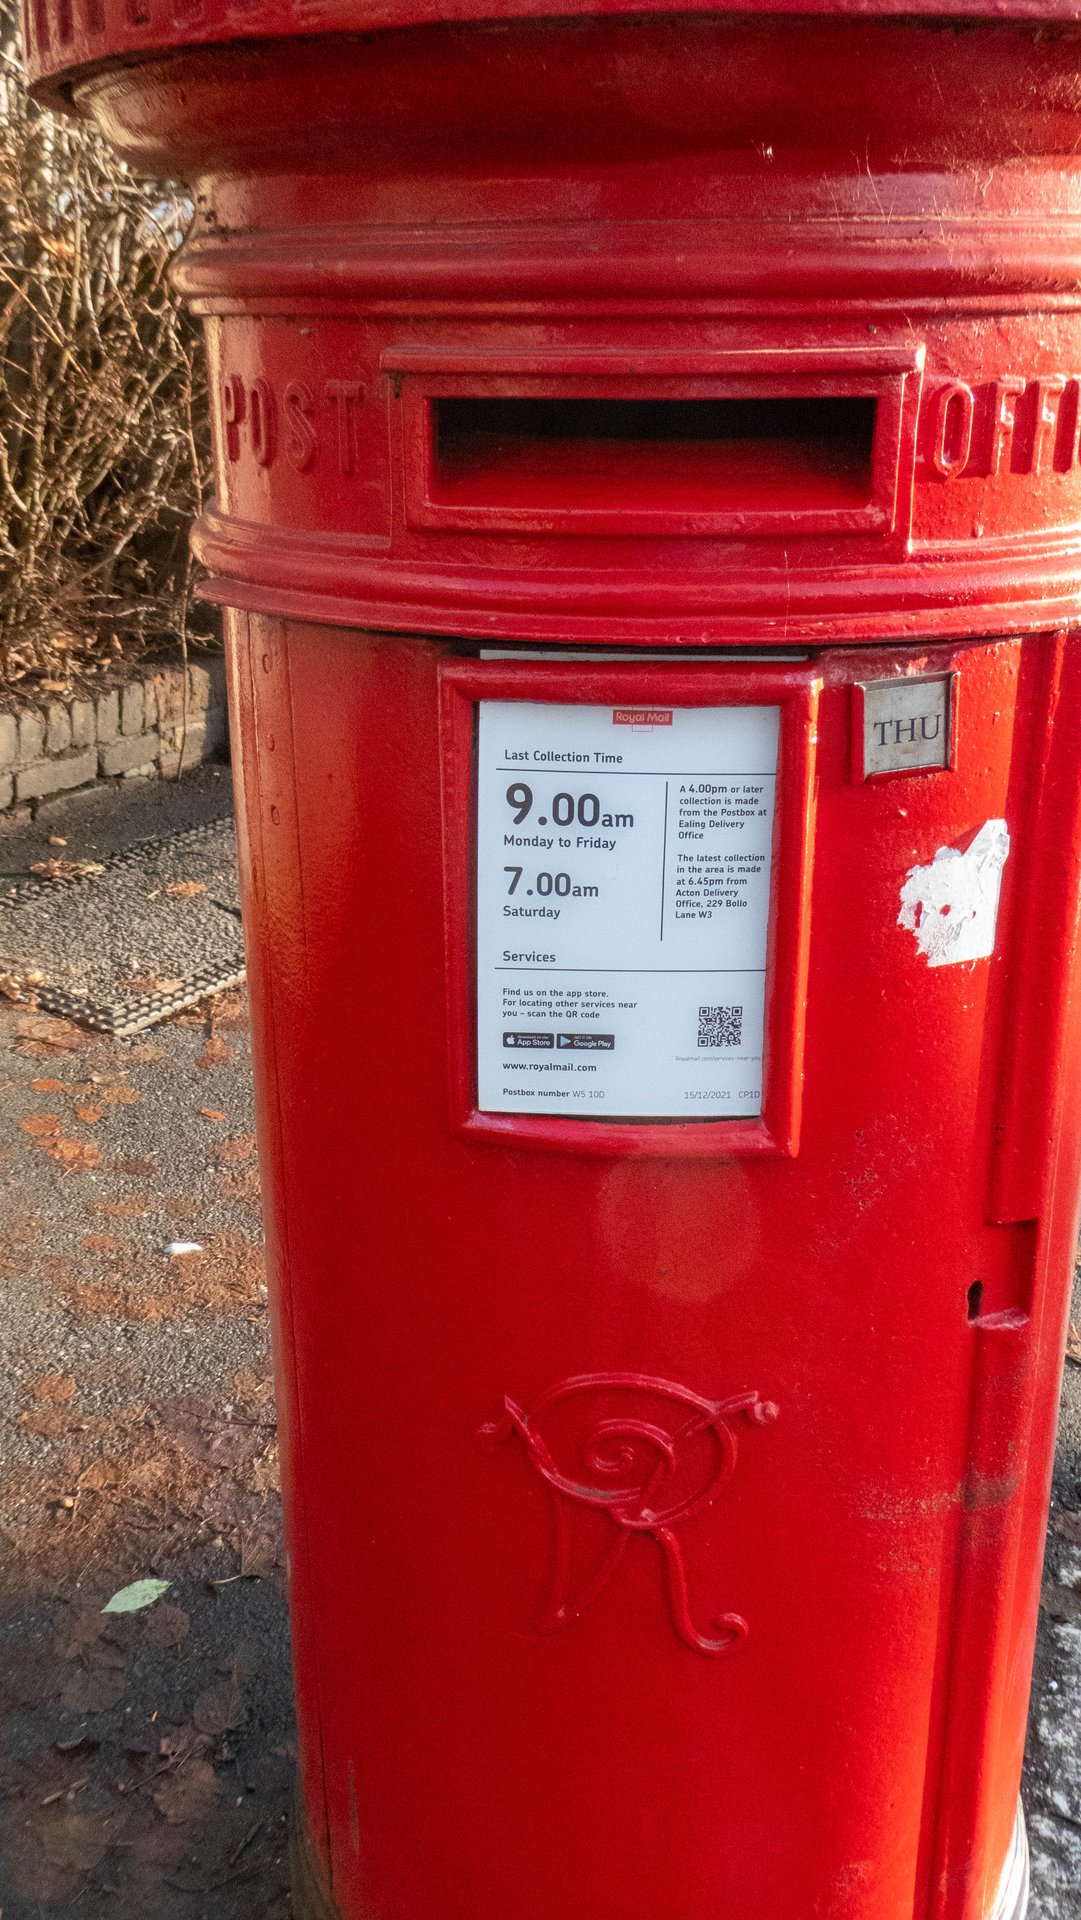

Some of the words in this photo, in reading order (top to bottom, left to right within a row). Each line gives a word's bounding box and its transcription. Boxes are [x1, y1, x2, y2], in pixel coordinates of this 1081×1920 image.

[223, 372, 367, 476] POST
[616, 711, 645, 723] Royal
[647, 712, 670, 722] Mail
[873, 714, 942, 747] THU
[505, 750, 529, 760] Last
[534, 751, 589, 762] Collection
[593, 753, 622, 763] Time
[680, 785, 686, 793] A
[689, 784, 727, 795] 4.00pm
[506, 783, 633, 827] 9.00am
[735, 797, 759, 805] made
[679, 808, 700, 816] from
[679, 820, 705, 829] Ealing
[709, 820, 744, 829] Delivery
[679, 831, 704, 839] Office
[504, 835, 553, 849] Monday
[559, 837, 571, 847] to
[577, 837, 616, 851] Friday
[678, 854, 693, 862] The
[728, 865, 734, 873] is
[504, 866, 598, 897] 7.00am
[688, 877, 723, 887] 6.45pm
[727, 877, 747, 885] from
[704, 889, 738, 897] Delivery
[676, 900, 703, 908] Office,
[503, 905, 560, 920] Saturday
[503, 951, 555, 962] Services
[566, 989, 583, 999] app
[519, 999, 552, 1008] locating
[517, 1039, 531, 1047] App
[574, 1040, 597, 1048] Google
[503, 1063, 596, 1072] www.royalmail.com
[503, 1088, 535, 1096] Postbox
[684, 1091, 731, 1099] 15/12/2021
